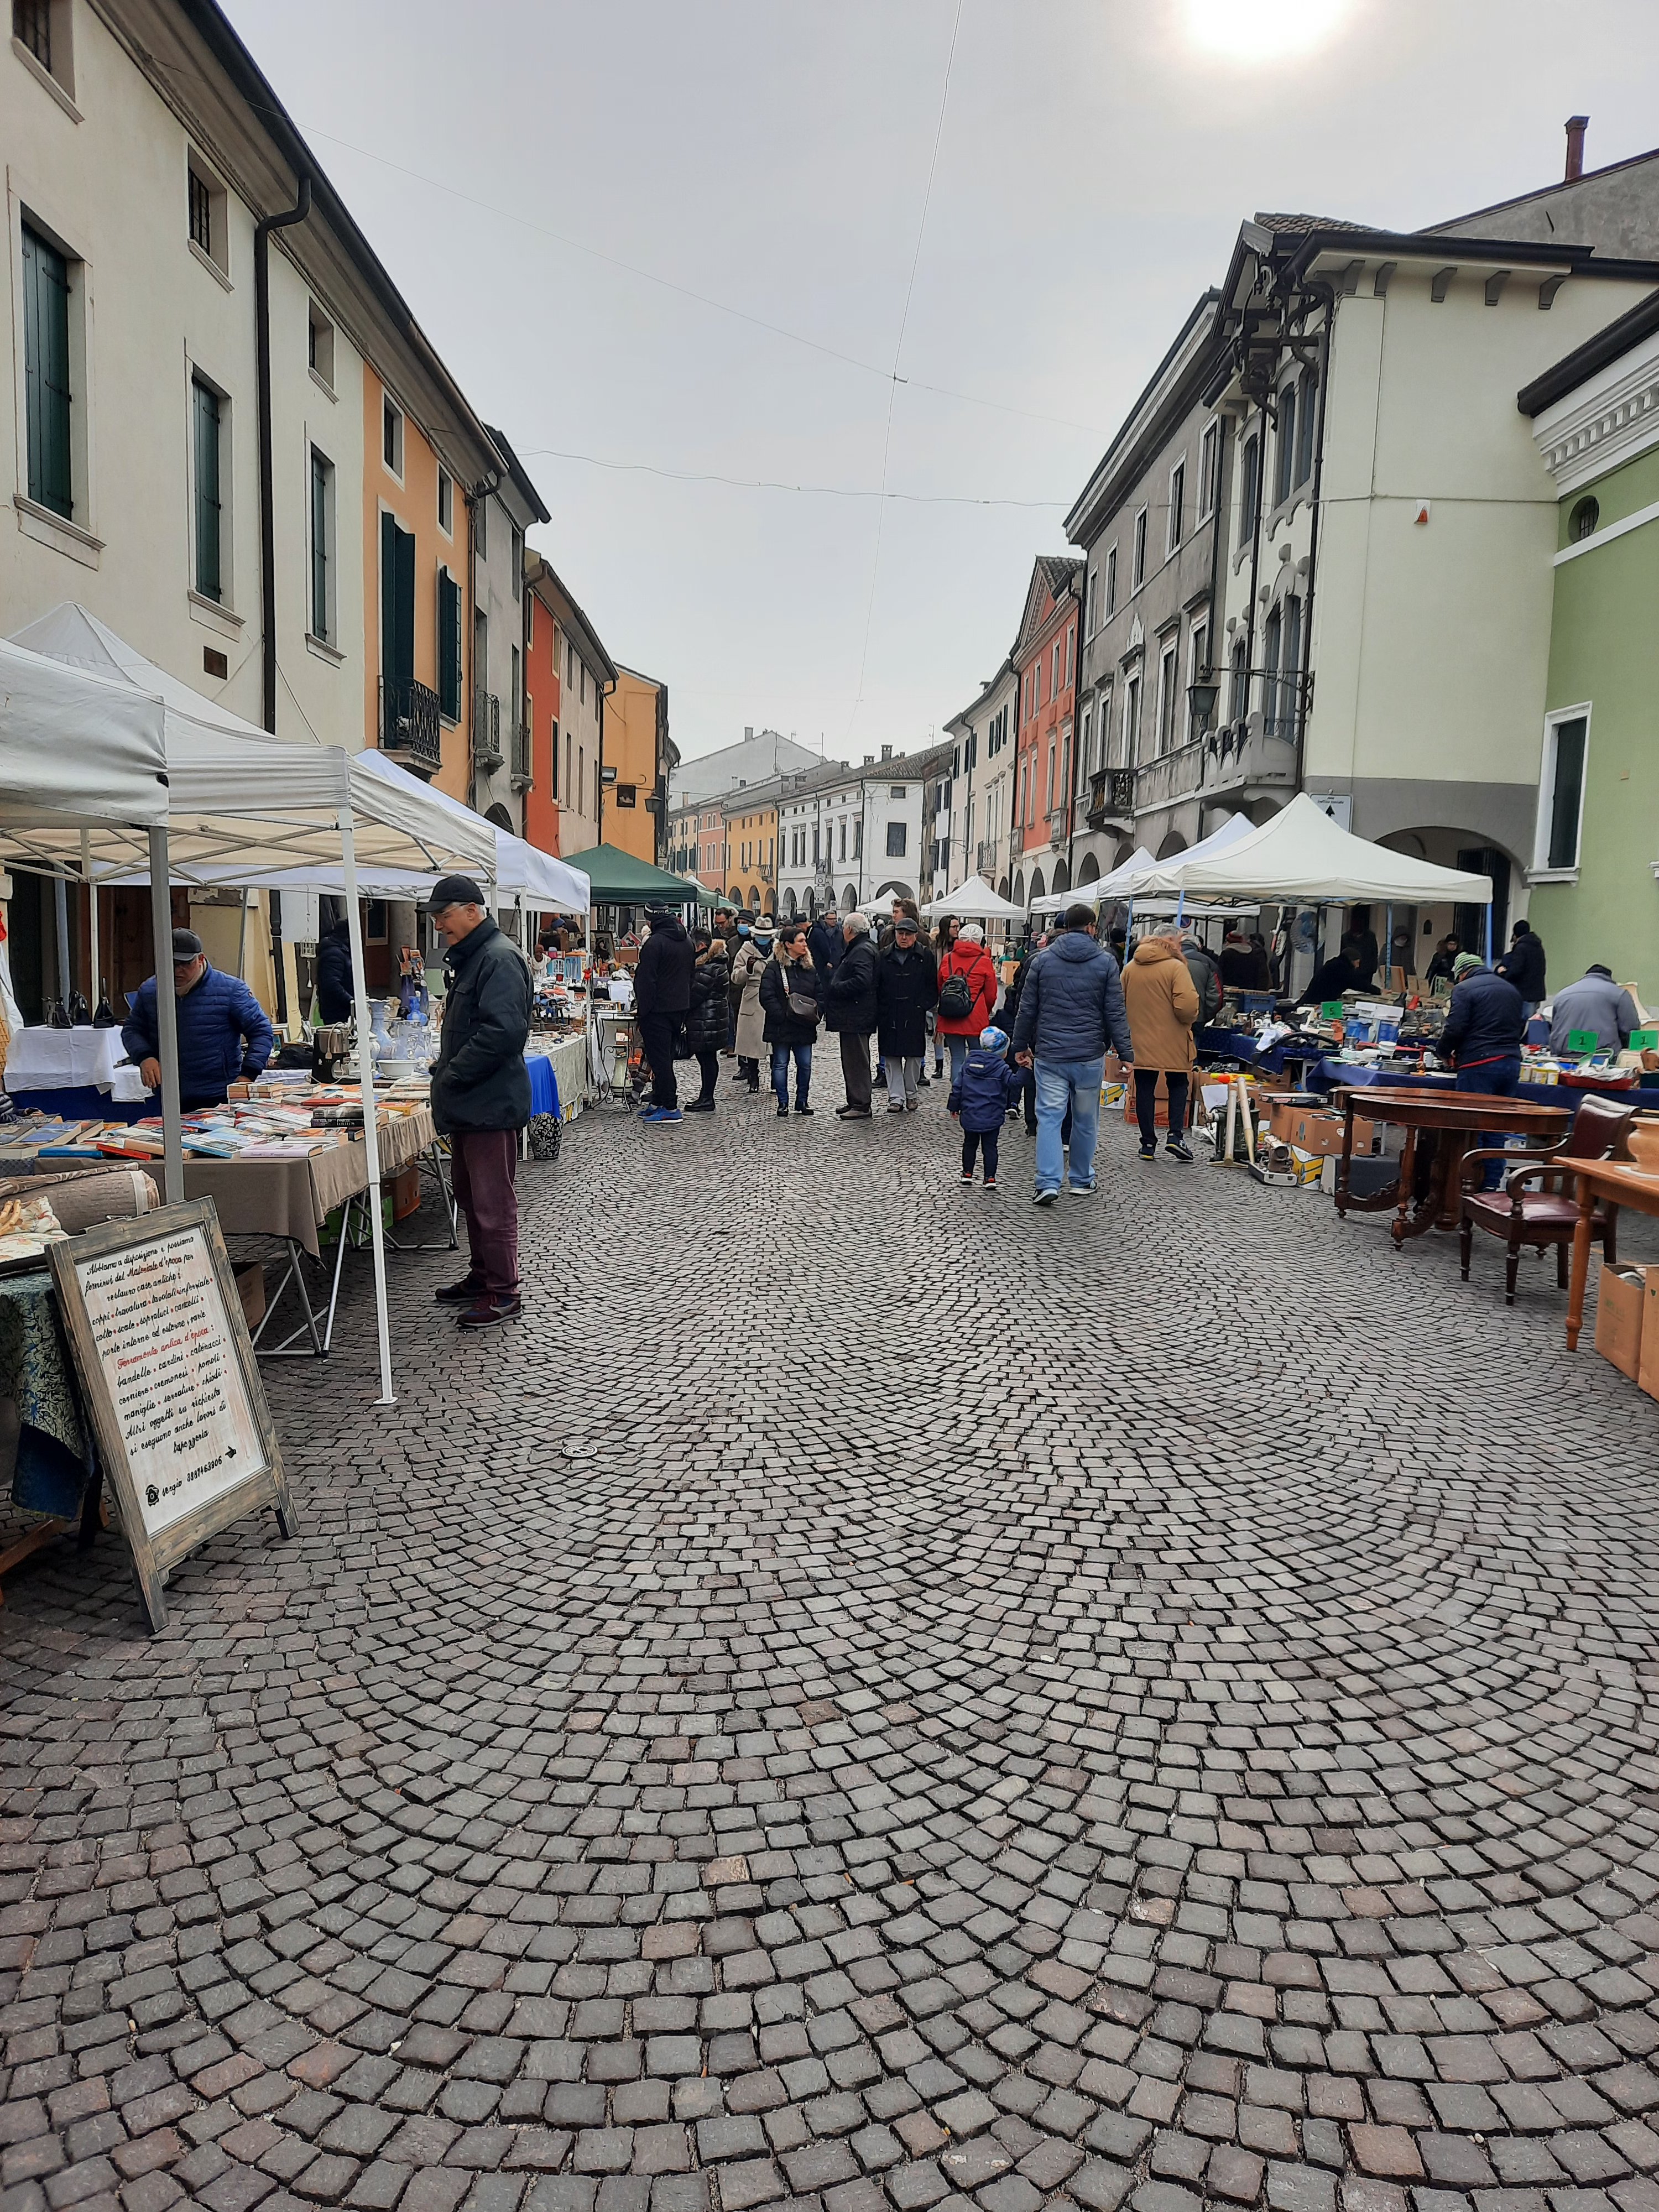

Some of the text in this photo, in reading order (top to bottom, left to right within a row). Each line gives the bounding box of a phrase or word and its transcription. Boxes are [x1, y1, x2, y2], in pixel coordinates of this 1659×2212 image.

[1329, 1006, 1335, 1015] 5
[1579, 1035, 1587, 1045] 1
[1640, 1035, 1647, 1045] 1
[87, 1261, 117, 1275] Abbiamo
[124, 1248, 158, 1265] disposizione
[167, 1237, 194, 1253] possiamo
[85, 1254, 194, 1297] fornirvi del Materiale d'epoca per
[107, 1285, 135, 1302] restauro
[137, 1281, 152, 1292] case
[92, 1311, 110, 1326] coppi
[115, 1300, 148, 1317] travatura
[152, 1290, 176, 1304] tavolati
[96, 1328, 113, 1342] cotto
[118, 1319, 135, 1333] scale
[174, 1295, 199, 1312] cancelli
[102, 1343, 120, 1361] porte
[122, 1333, 150, 1349] interne
[152, 1326, 160, 1337] ed
[190, 1310, 206, 1323] varie
[117, 1346, 159, 1370] Ferramenta
[160, 1337, 183, 1352] antica
[117, 1334, 221, 1388] bandelle cardini catenacci
[119, 1352, 220, 1405] cerniere cremonesi pomoli
[124, 1368, 222, 1421] maniglie serrature chiodi
[125, 1386, 220, 1439] Altri oggetti su richiesta
[129, 1400, 227, 1455] si eseguono anche lavori di
[173, 1429, 209, 1454] tapezzeria
[162, 1478, 182, 1496] sergio
